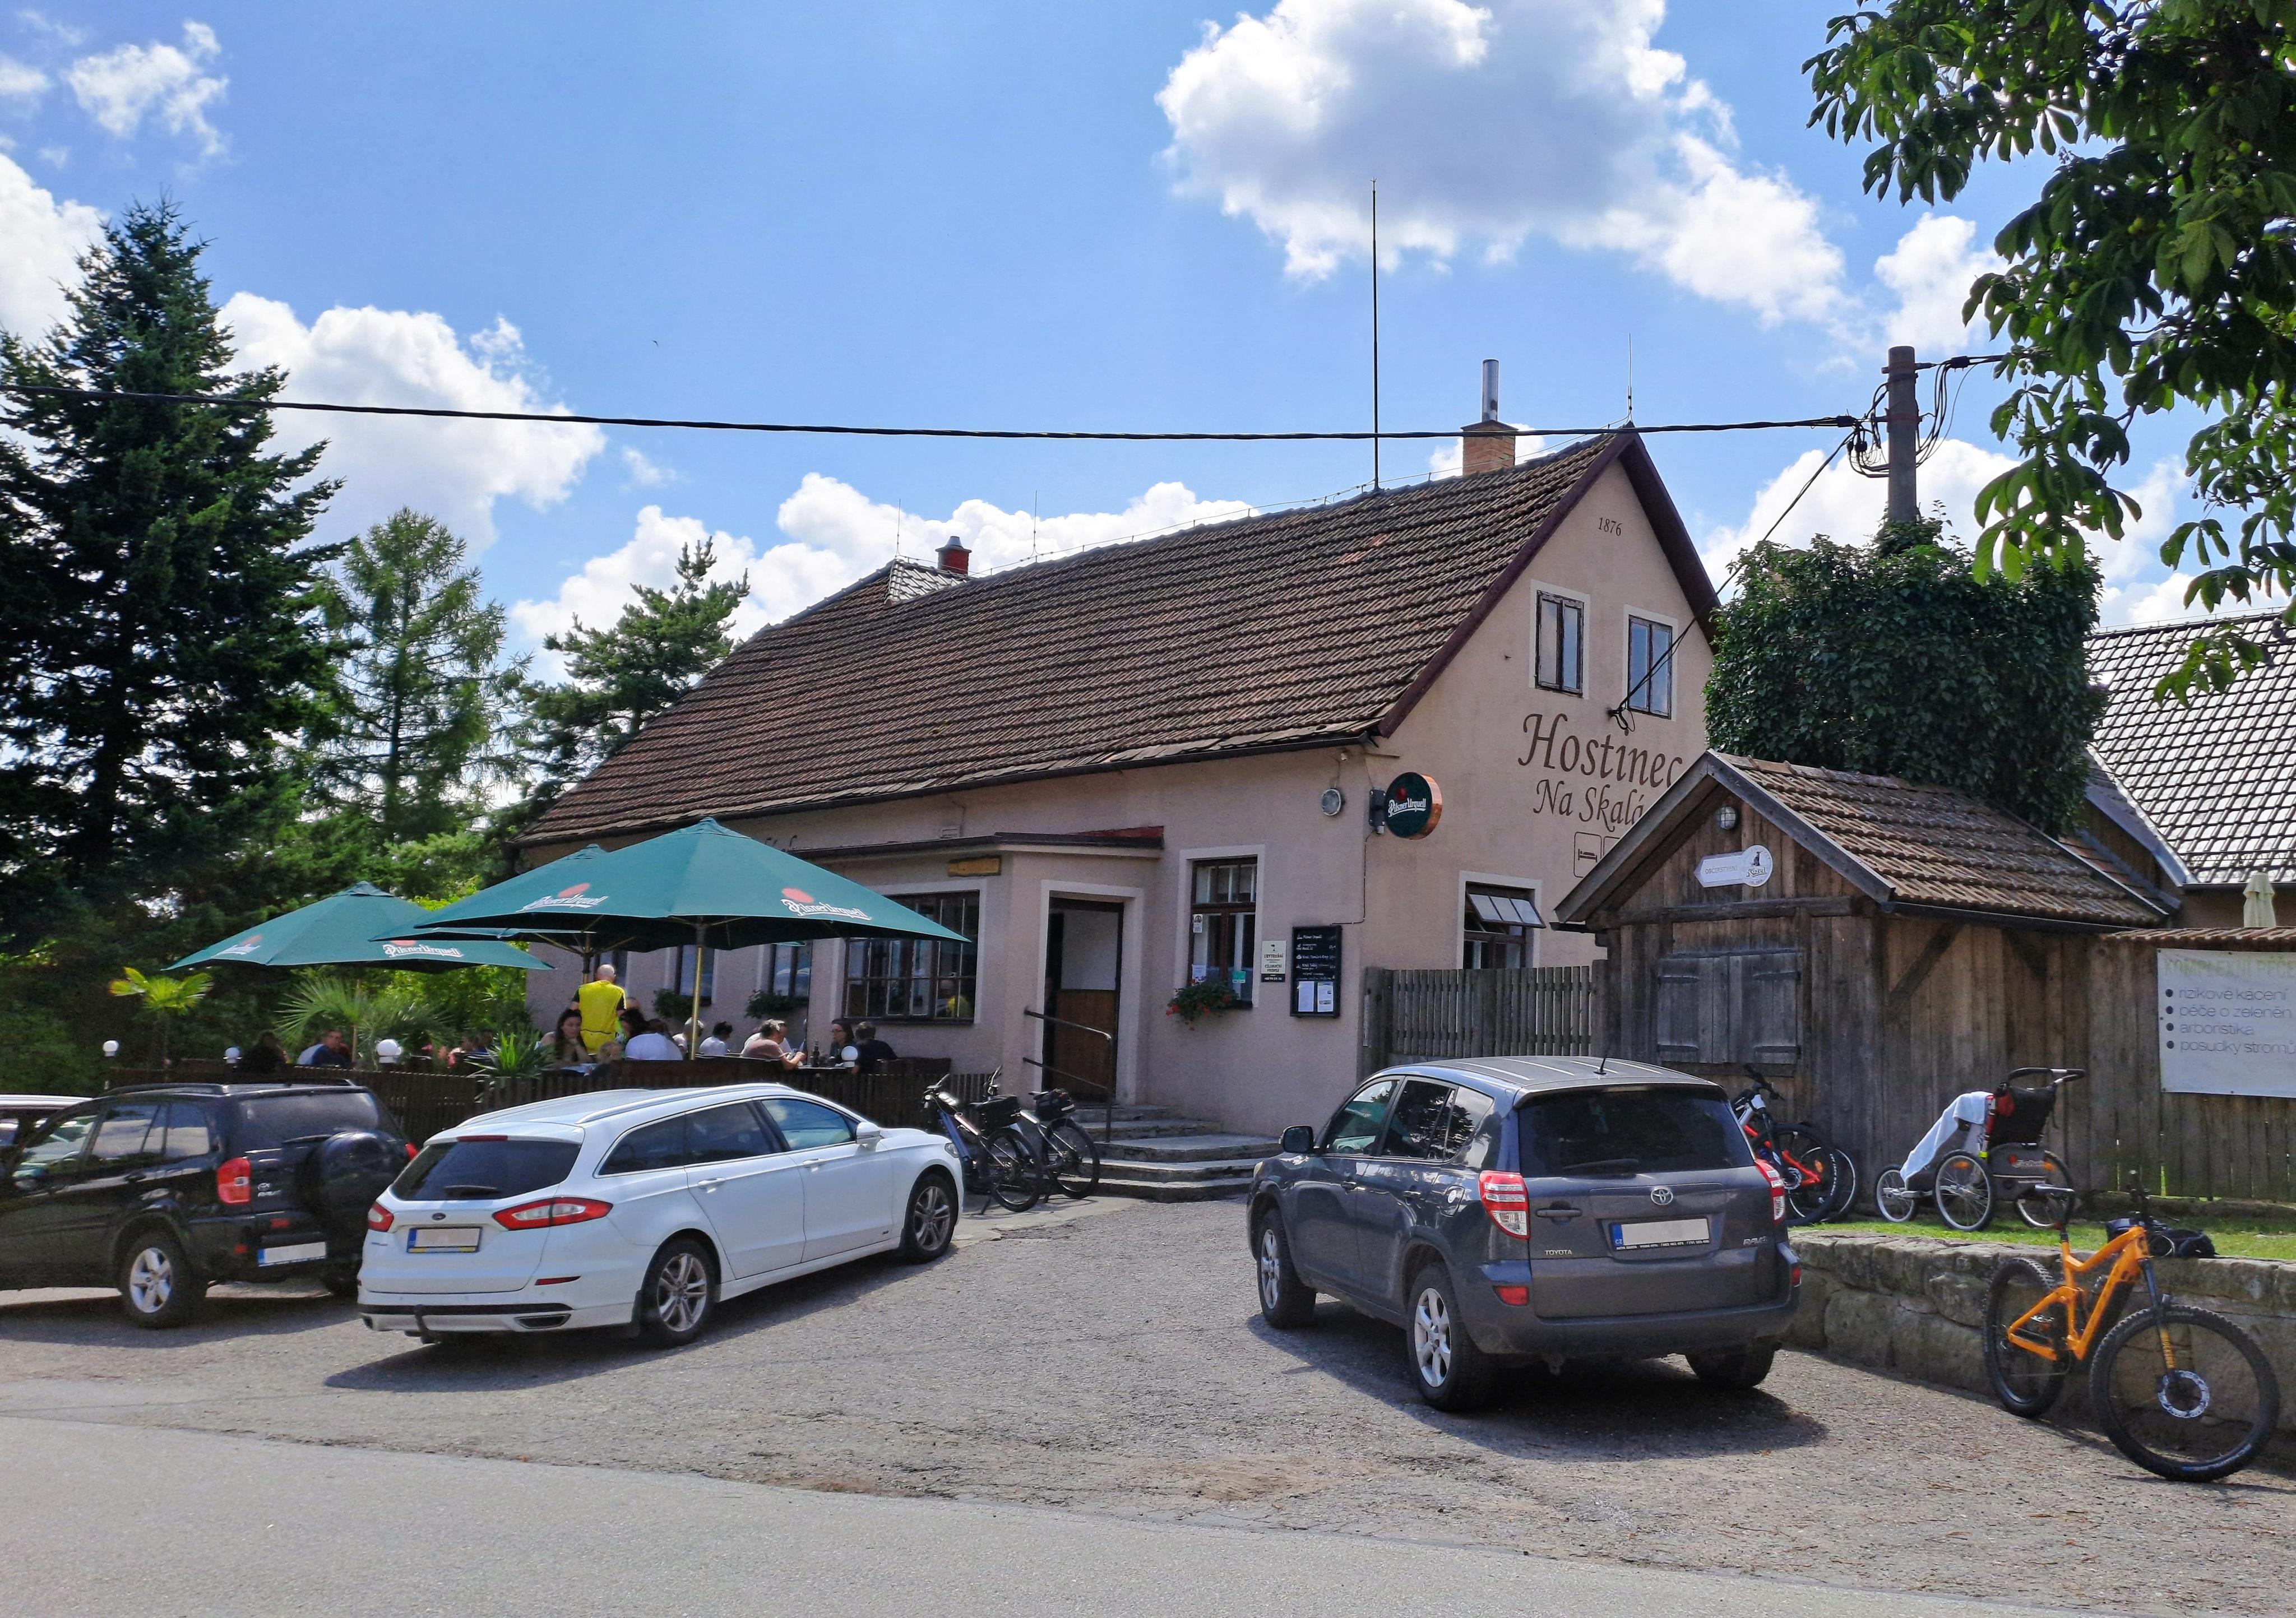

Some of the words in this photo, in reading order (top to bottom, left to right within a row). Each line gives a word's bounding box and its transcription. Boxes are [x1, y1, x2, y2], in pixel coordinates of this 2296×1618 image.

[1598, 517, 1623, 536] 1876
[1518, 713, 1683, 788] Hostinec
[1533, 778, 1573, 817] Na
[1388, 799, 1408, 817] Pilsner
[1407, 798, 1426, 812] Urquell
[1746, 866, 1767, 877] Kozel
[780, 898, 826, 916] Pilsner
[819, 901, 871, 919] Urquell
[382, 944, 423, 957] Pilsner
[419, 944, 462, 956] Urquell
[2179, 987, 2233, 1000] rizikové
[2237, 988, 2289, 1000] kácení
[2179, 1004, 2216, 1018] péče
[2220, 1008, 2230, 1017] o
[2180, 1023, 2254, 1035] arboristika
[2180, 1041, 2241, 1054] posudky
[2244, 1040, 2296, 1054] stromů
